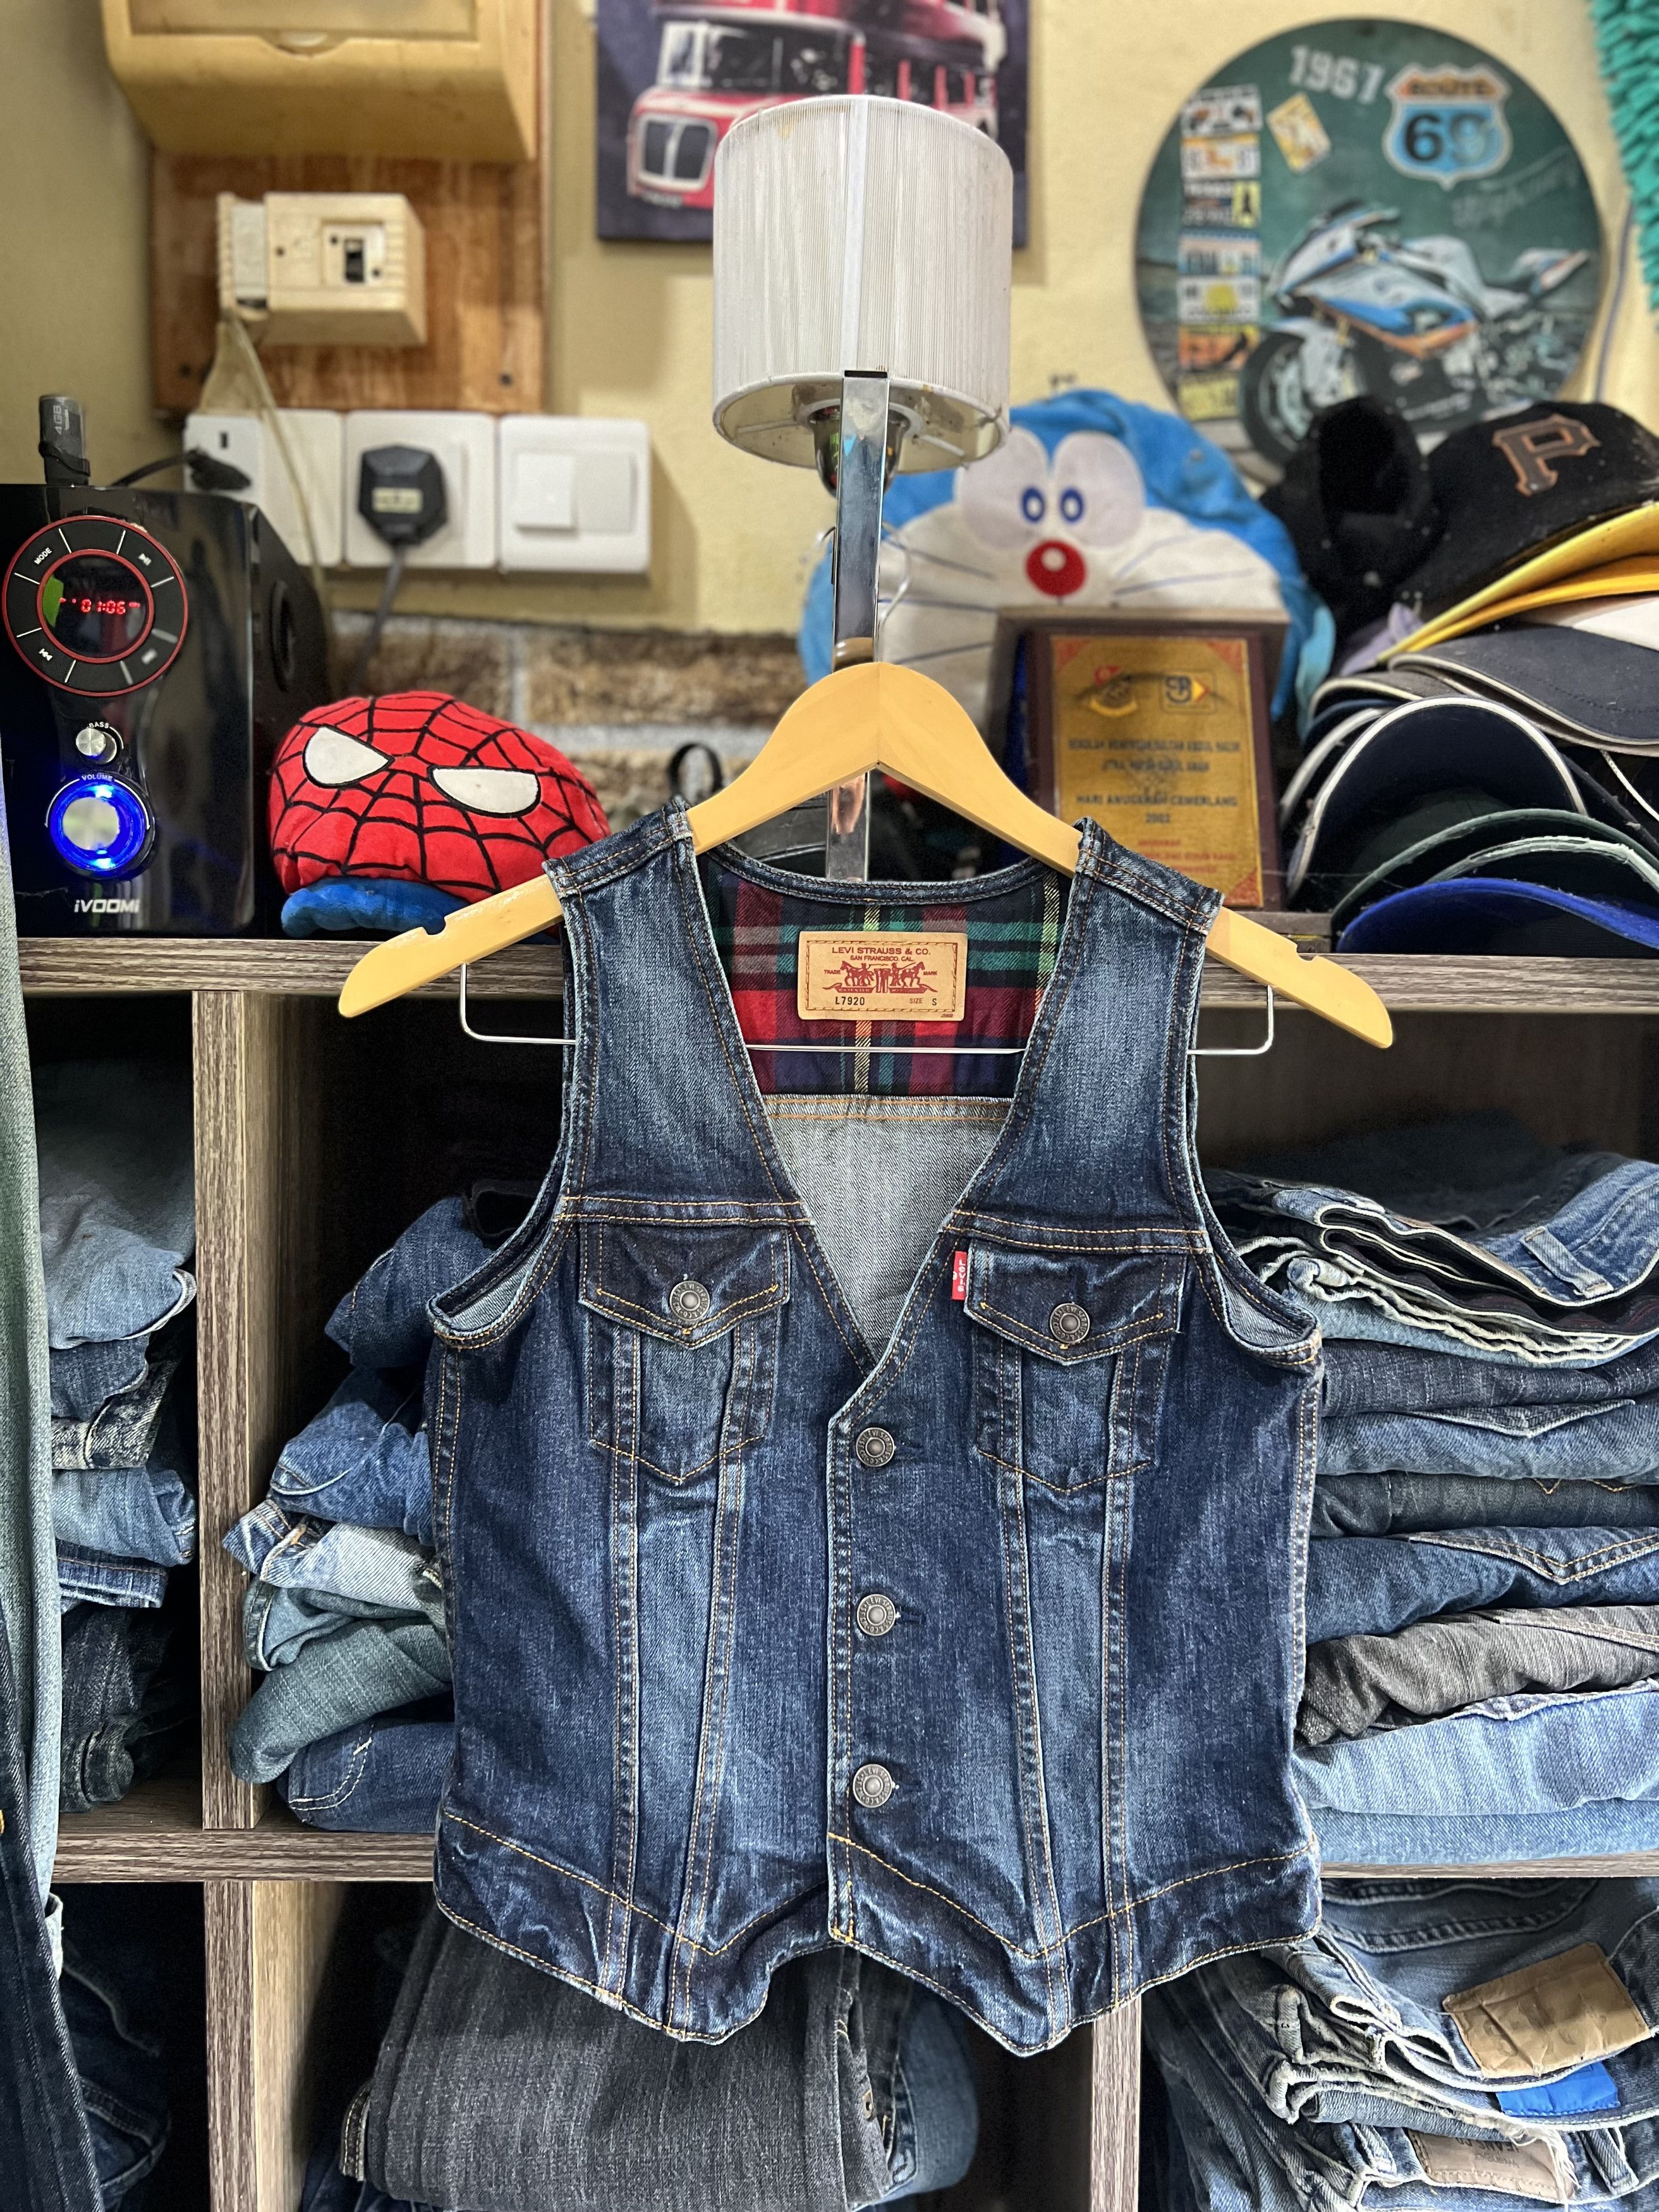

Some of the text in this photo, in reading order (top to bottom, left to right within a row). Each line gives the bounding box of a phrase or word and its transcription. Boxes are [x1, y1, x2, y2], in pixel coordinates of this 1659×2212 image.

[1289, 45, 1385, 105] 1967
[53, 405, 63, 435] 4GB
[1492, 414, 1602, 498] P
[34, 547, 52, 565] MODE
[80, 599, 126, 615] 01:06
[88, 721, 110, 729] BASS
[81, 772, 113, 782] VOLUME
[835, 996, 865, 1006] L7920
